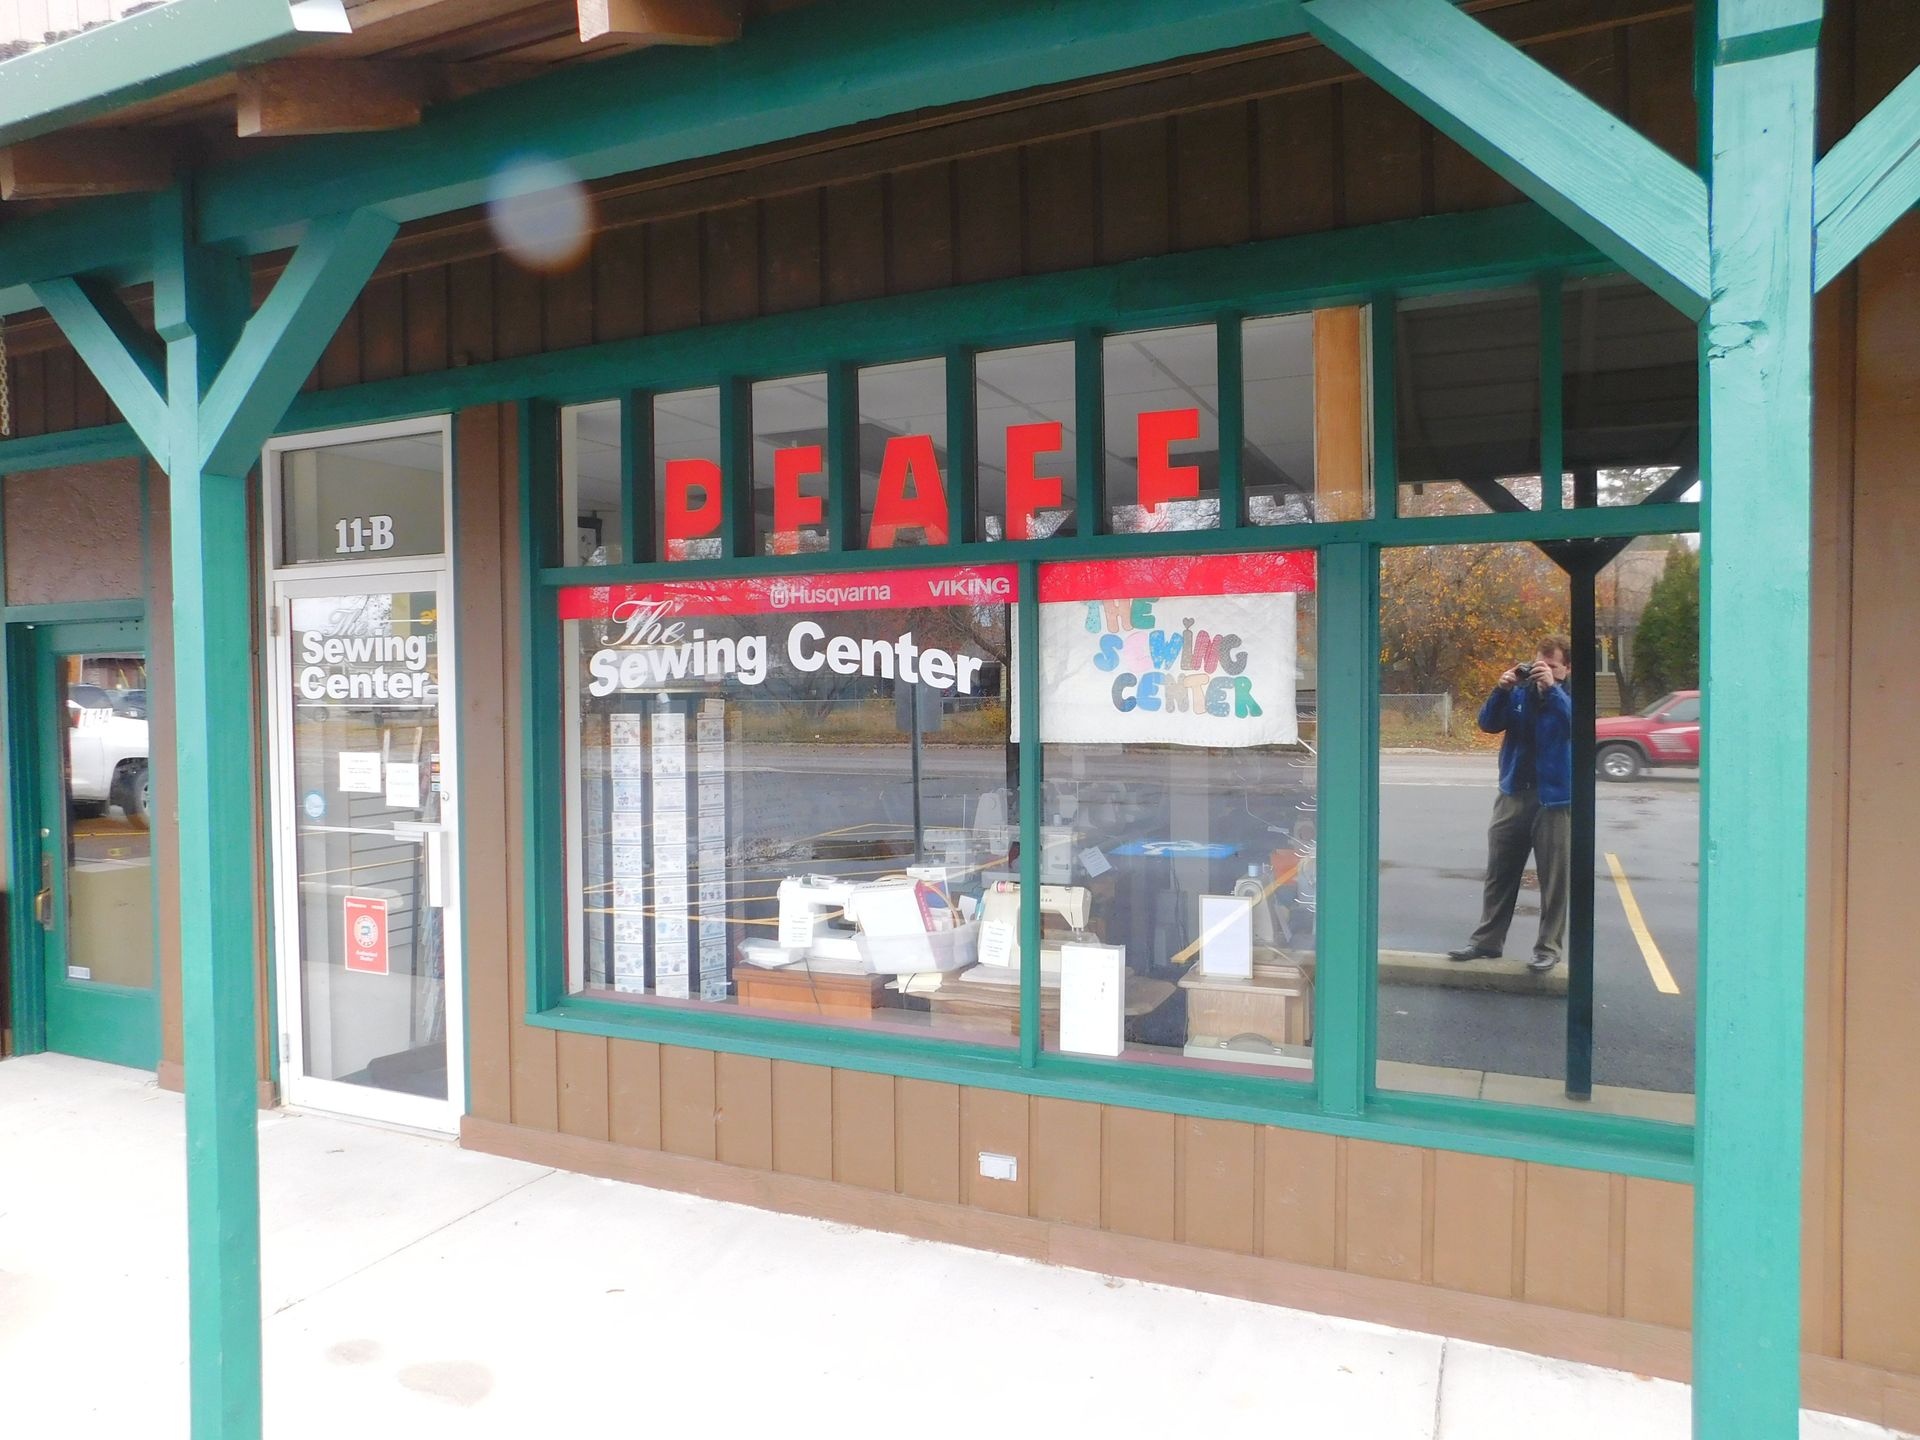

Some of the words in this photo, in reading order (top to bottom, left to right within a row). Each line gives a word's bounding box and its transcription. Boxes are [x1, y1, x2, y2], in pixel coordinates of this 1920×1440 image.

[665, 408, 1199, 562] PFAFF
[335, 515, 394, 554] 11-B
[790, 583, 891, 606] Husqvarna
[928, 577, 1010, 597] VIKING
[601, 600, 685, 646] The
[1080, 598, 1160, 633] THE
[302, 630, 427, 671] Sewing
[589, 628, 766, 697] Sewing
[787, 621, 983, 695] Center
[300, 666, 429, 699] Center
[1111, 671, 1263, 719] CENTER
